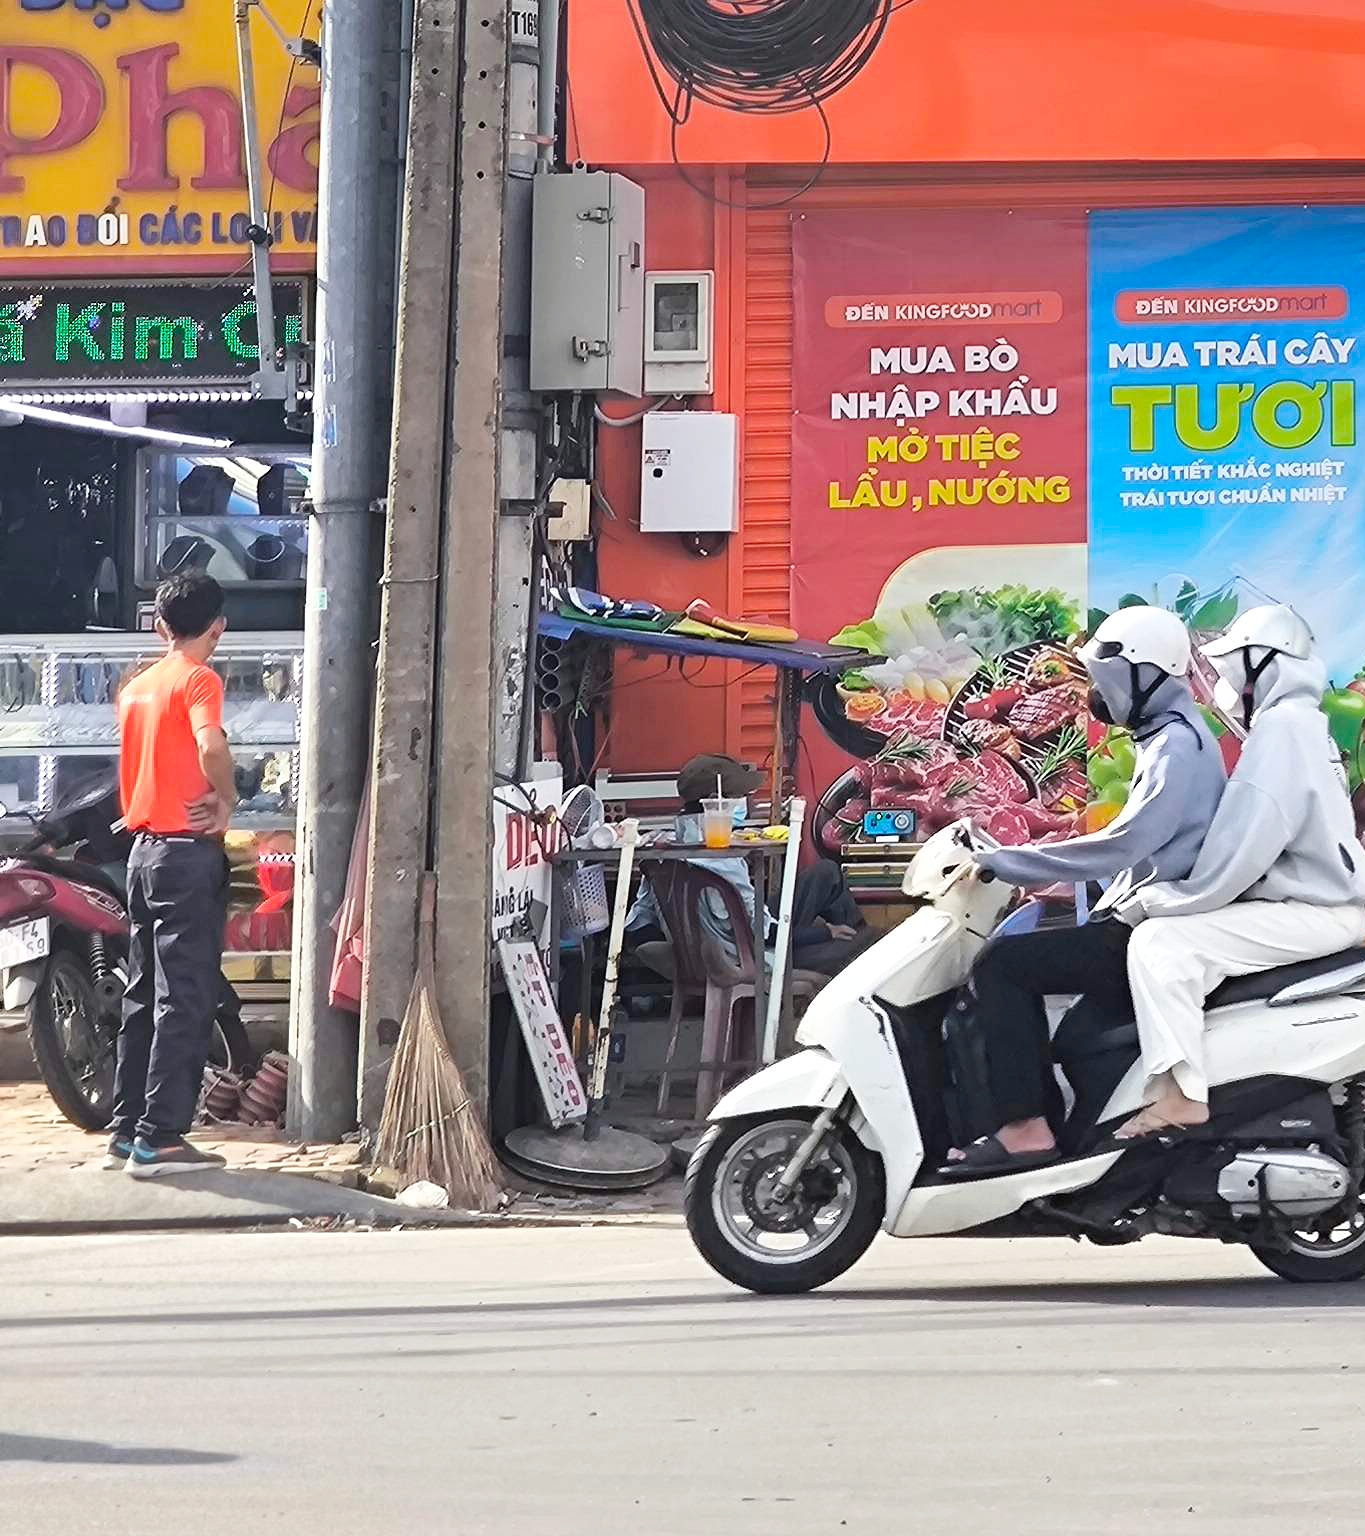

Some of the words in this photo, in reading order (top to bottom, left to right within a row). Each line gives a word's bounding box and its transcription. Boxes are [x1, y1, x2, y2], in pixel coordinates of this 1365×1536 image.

[140, 205, 202, 244] CÁC
[845, 302, 889, 321] ĐẾN
[1136, 296, 1178, 315] ĐẾN
[55, 302, 199, 361] Kim
[870, 346, 955, 375] MUA
[964, 337, 1019, 374] BÒ
[1108, 341, 1189, 369] MUA
[1193, 332, 1277, 367] TRÁI
[1283, 332, 1355, 365] CÂY
[831, 384, 940, 427] NHẬP
[949, 375, 1058, 417] KHẨU
[1111, 379, 1356, 452] TƯƠI
[867, 427, 929, 464] MỞ
[935, 426, 1021, 468] TIỆC
[1122, 462, 1168, 481] THỜI
[1171, 458, 1213, 480] TIẾT
[1217, 456, 1271, 479] KHẮC
[1275, 458, 1345, 480] NGHIỆT
[928, 470, 1071, 505] NƯỚNG
[1120, 487, 1164, 507] TRÁI
[1167, 490, 1216, 506] TƯƠI
[1218, 483, 1287, 505] CHUẨN
[1290, 483, 1347, 506] NHIỆT
